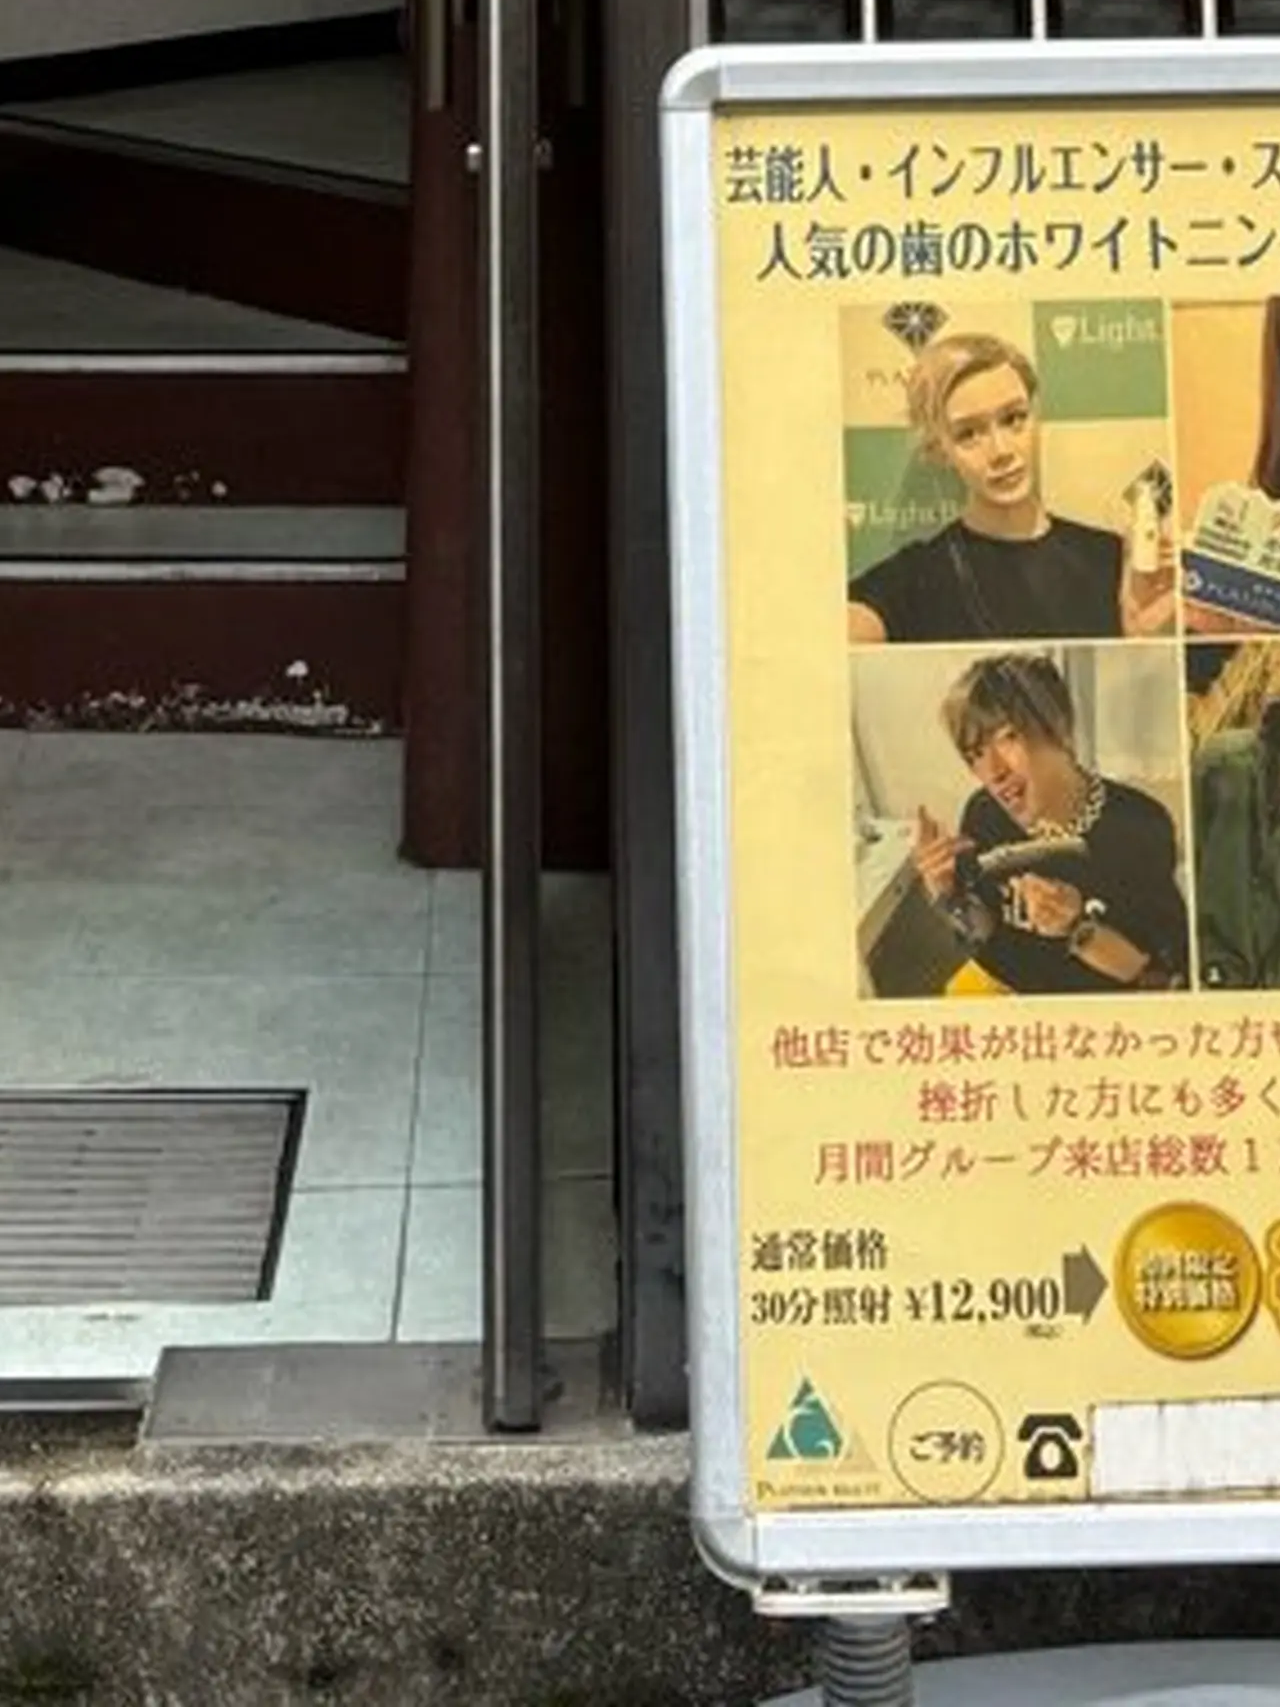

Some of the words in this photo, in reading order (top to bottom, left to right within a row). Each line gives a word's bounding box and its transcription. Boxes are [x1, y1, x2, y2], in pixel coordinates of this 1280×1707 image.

[751, 1228, 887, 1272] 通常価格
[751, 1287, 893, 1326] 30分照射
[905, 1277, 1062, 1323] ¥12,900
[909, 1429, 986, 1464] ご予約
